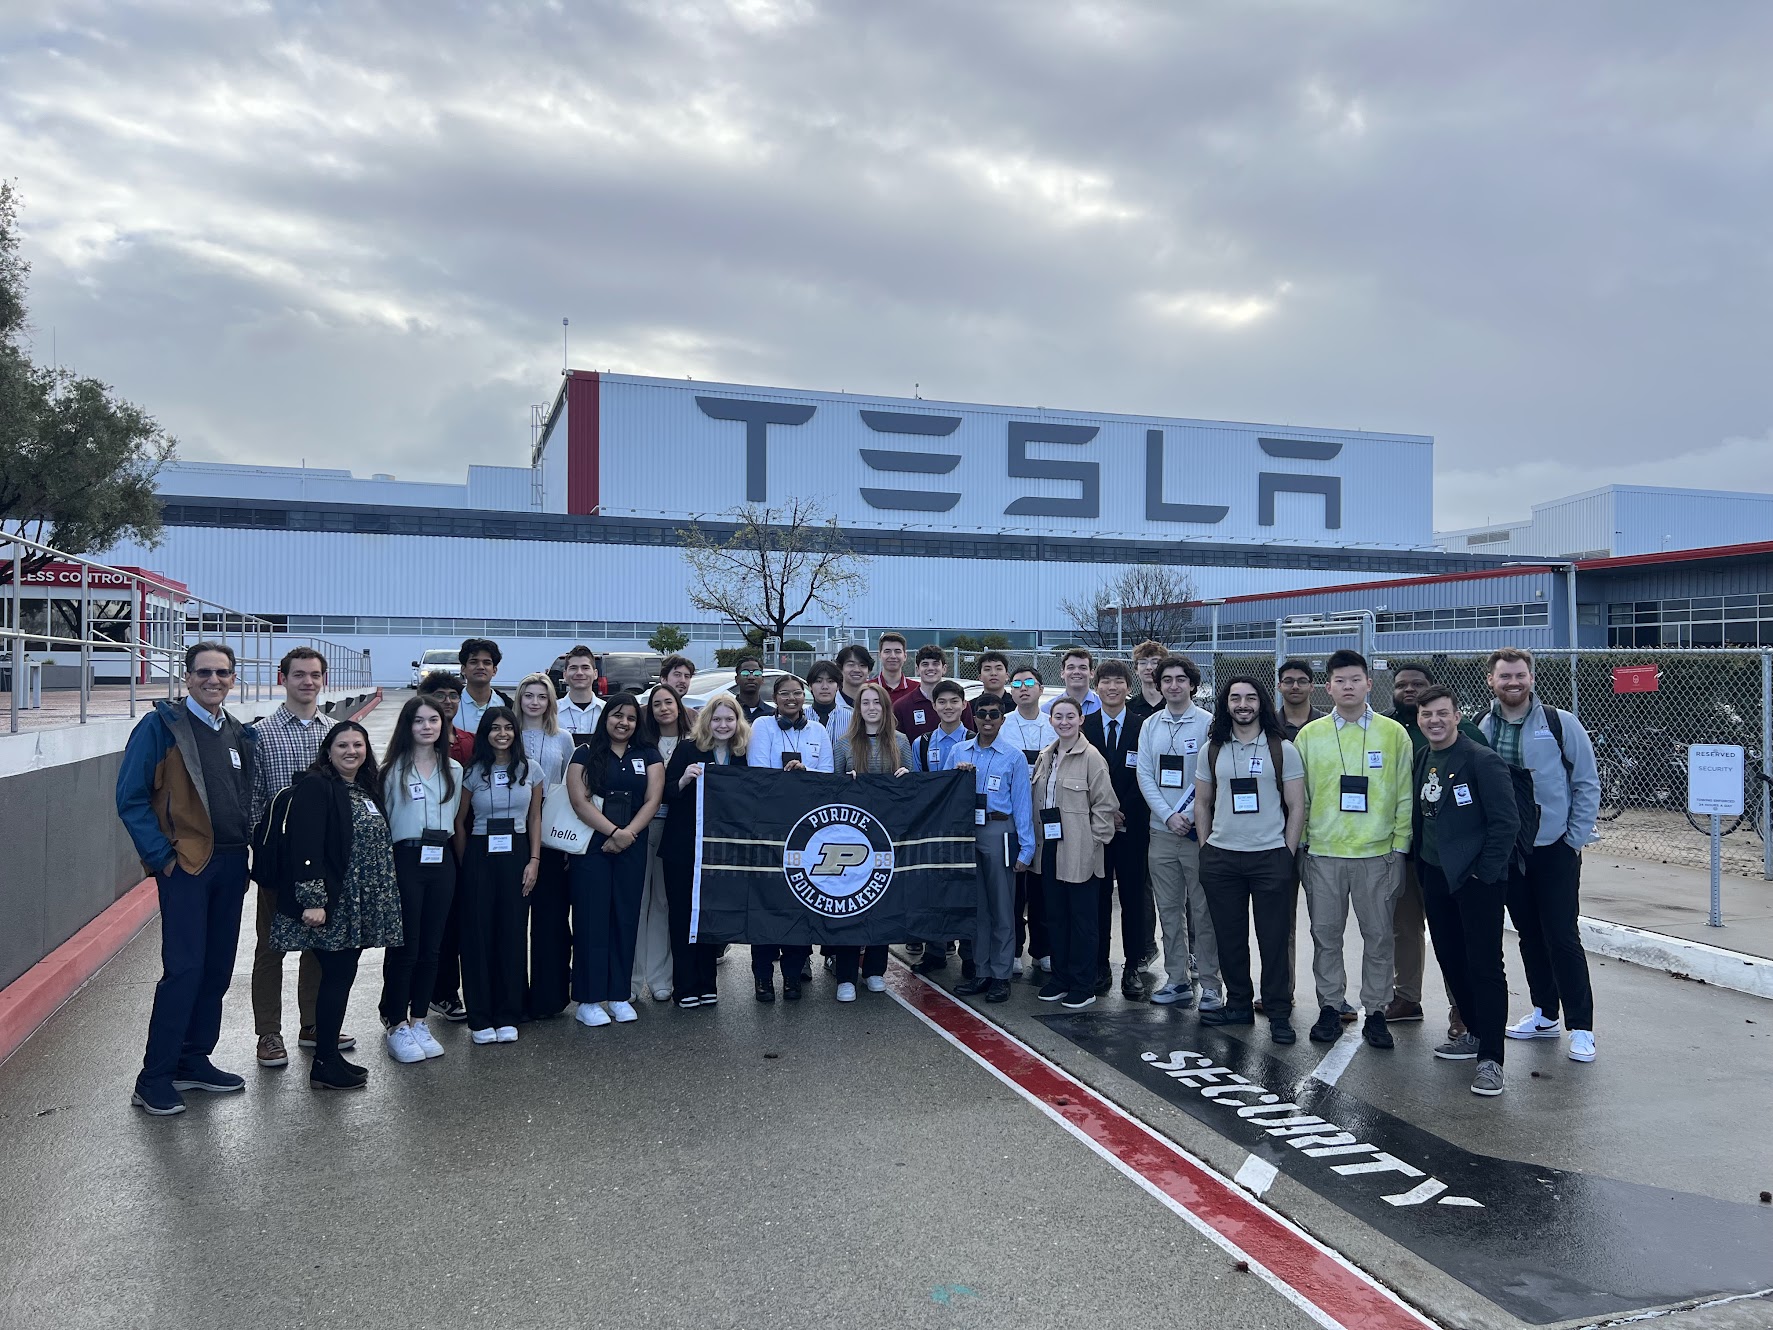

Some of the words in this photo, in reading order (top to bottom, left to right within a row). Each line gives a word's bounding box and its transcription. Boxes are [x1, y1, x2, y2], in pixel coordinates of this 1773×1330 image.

[695, 395, 1343, 530] TESLA
[550, 826, 578, 841] hello.
[786, 851, 801, 867] 18
[874, 852, 893, 868] 69
[1140, 1050, 1486, 1207] SECURITY
